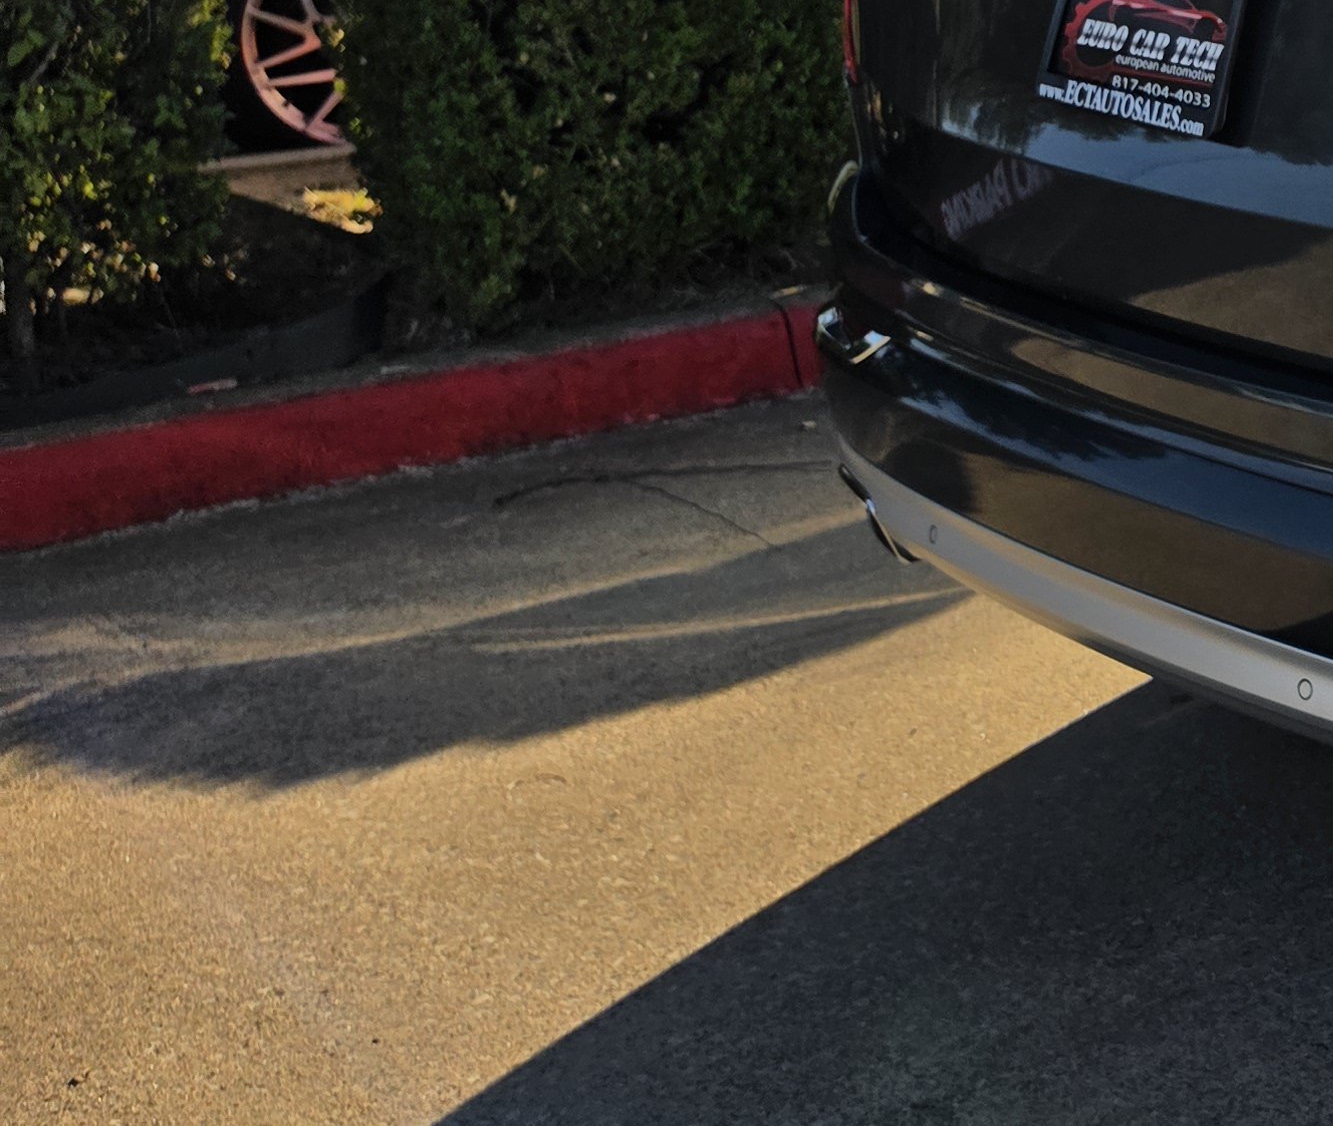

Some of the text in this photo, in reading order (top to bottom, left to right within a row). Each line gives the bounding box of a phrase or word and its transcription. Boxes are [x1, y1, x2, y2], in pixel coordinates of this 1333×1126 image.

[1077, 18, 1225, 71] EURO CAR TECH
[1115, 54, 1216, 84] european automotive
[1039, 79, 1204, 136] www.ECTAUTOSALES.com
[1111, 74, 1211, 108] 817-404-4033
